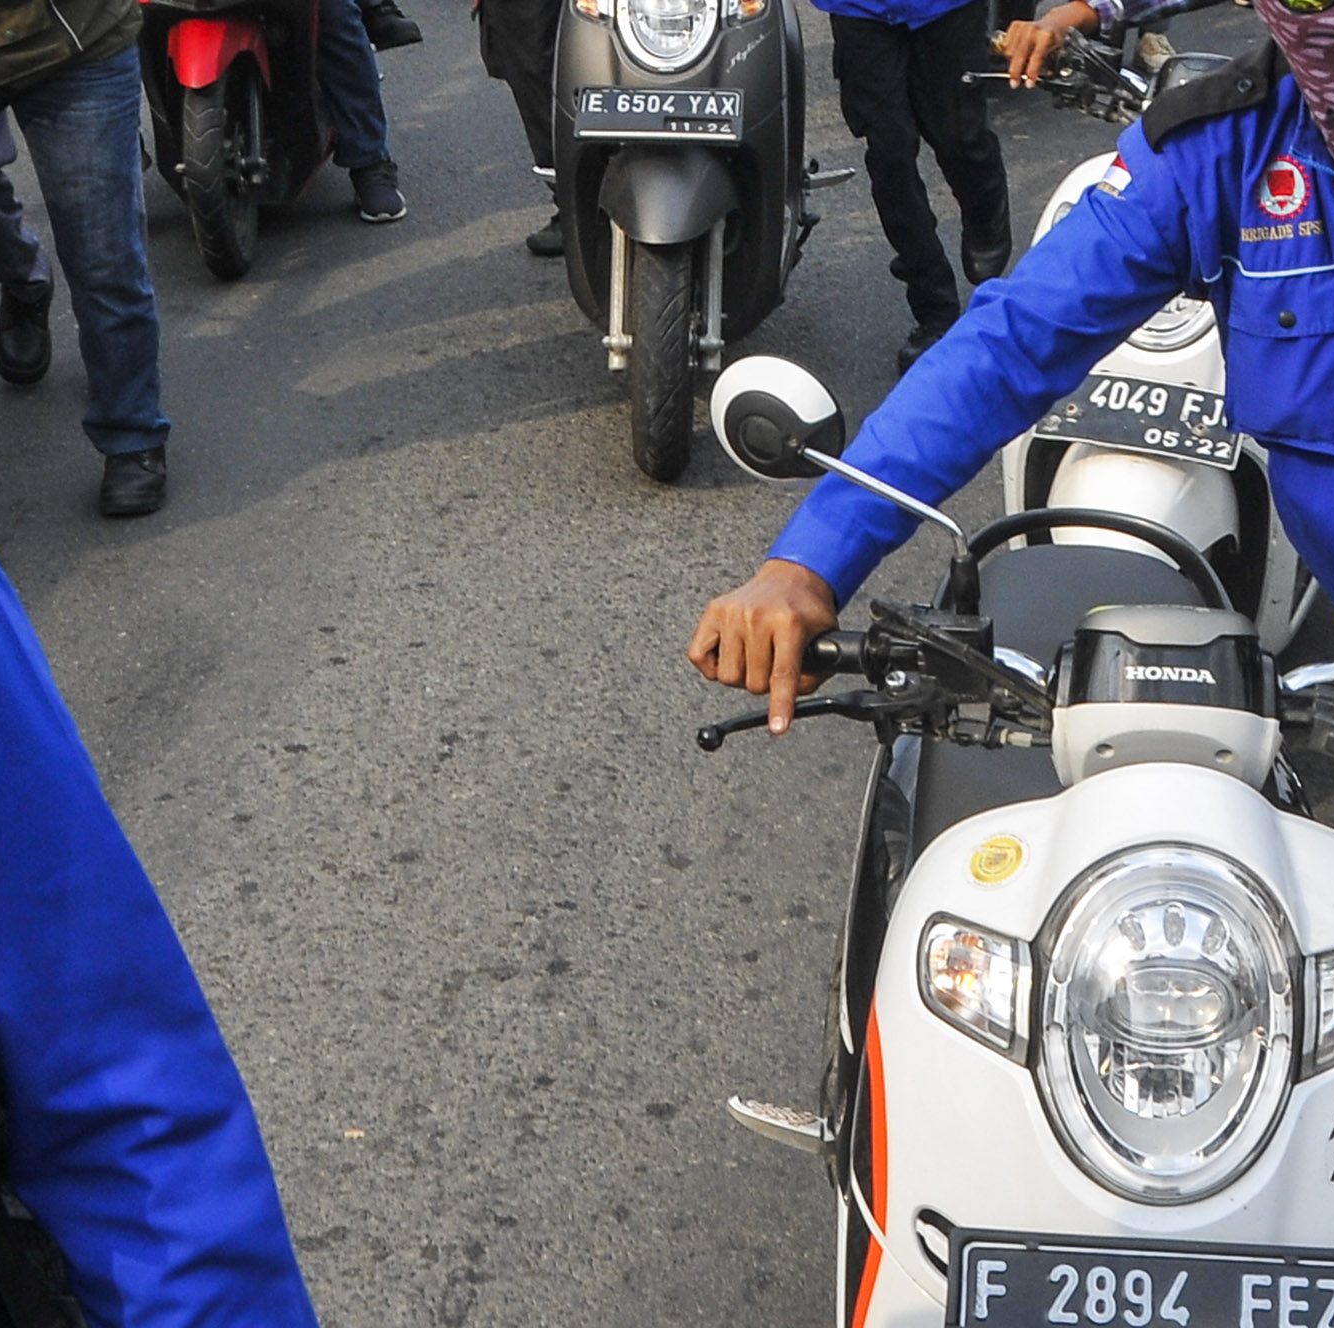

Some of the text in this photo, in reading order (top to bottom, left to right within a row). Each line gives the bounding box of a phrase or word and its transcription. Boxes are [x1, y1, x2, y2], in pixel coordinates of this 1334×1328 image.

[616, 94, 676, 114] 6504
[689, 95, 736, 116] YAX
[1241, 223, 1294, 243] BRIGADE
[1089, 379, 1229, 428] 4049 FJ
[1124, 665, 1216, 685] HONDA
[974, 1259, 1008, 1320] F
[1047, 1263, 1191, 1327] 2894
